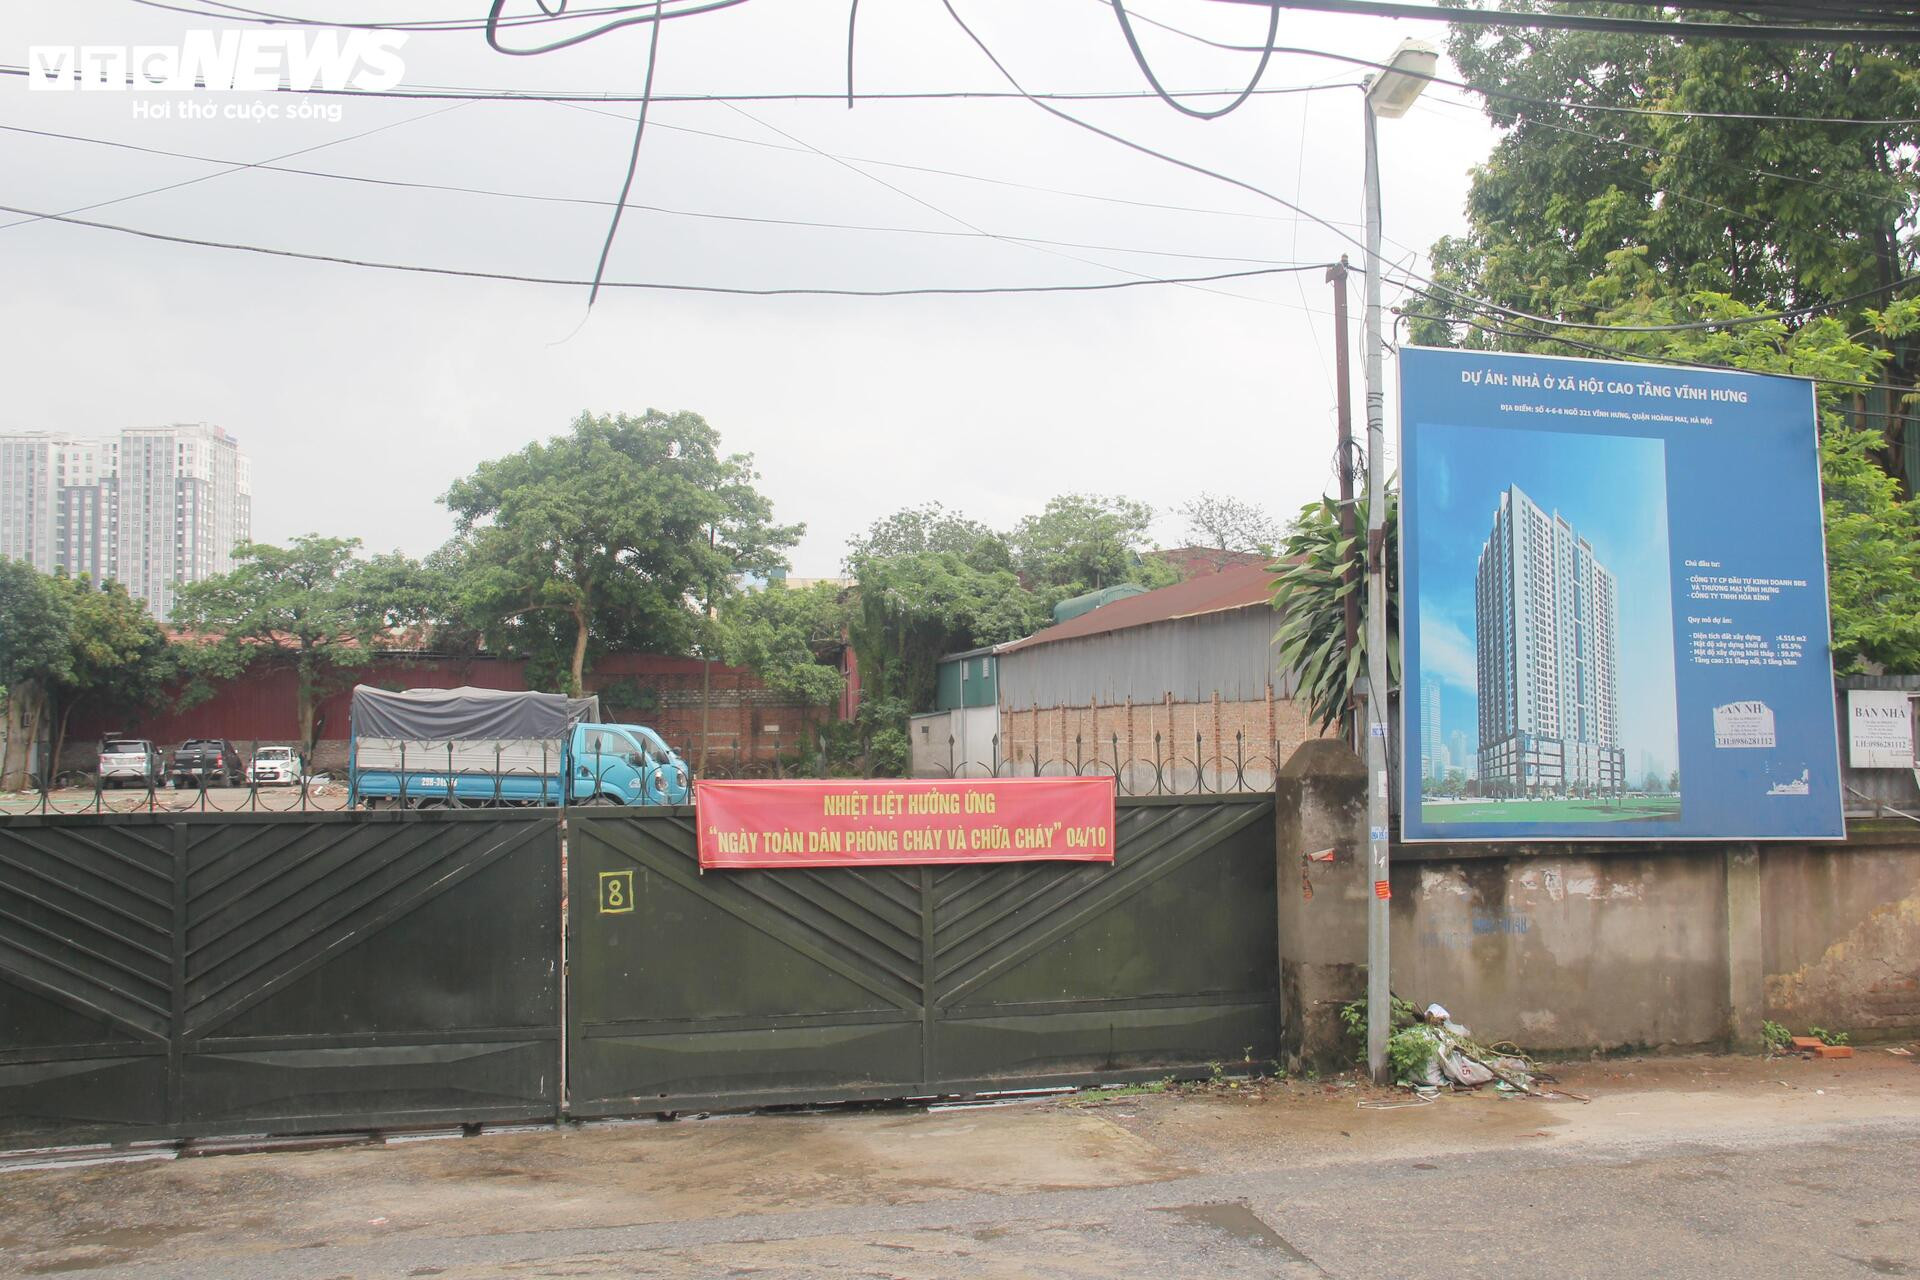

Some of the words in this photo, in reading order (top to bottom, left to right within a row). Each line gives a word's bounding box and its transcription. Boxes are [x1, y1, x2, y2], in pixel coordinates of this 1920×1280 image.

[1461, 370, 1482, 386] DỰ
[1485, 369, 1508, 385] ÁN:
[1512, 373, 1540, 388] NHÀ
[1543, 374, 1555, 389] Ở
[1558, 376, 1575, 391] XÃ
[1579, 377, 1603, 394] HỘI
[1607, 382, 1633, 395] CAO
[1636, 380, 1671, 398] TẦNG
[1674, 384, 1707, 400] VĨNH
[1711, 388, 1748, 403] HƯNG
[824, 790, 868, 820] NHIỆT
[872, 790, 904, 820] LIỆT
[908, 787, 960, 815] HƯỞNG
[964, 789, 996, 814] ỨNG
[763, 827, 804, 853] TOÀN
[808, 826, 841, 853] DÂN
[845, 826, 898, 852] PHÒNG
[903, 825, 943, 851] CHÁY
[946, 825, 967, 850] VÀ
[971, 824, 1011, 850] CHỮA
[1066, 826, 1106, 848] 04/10
[608, 879, 623, 906] 8
